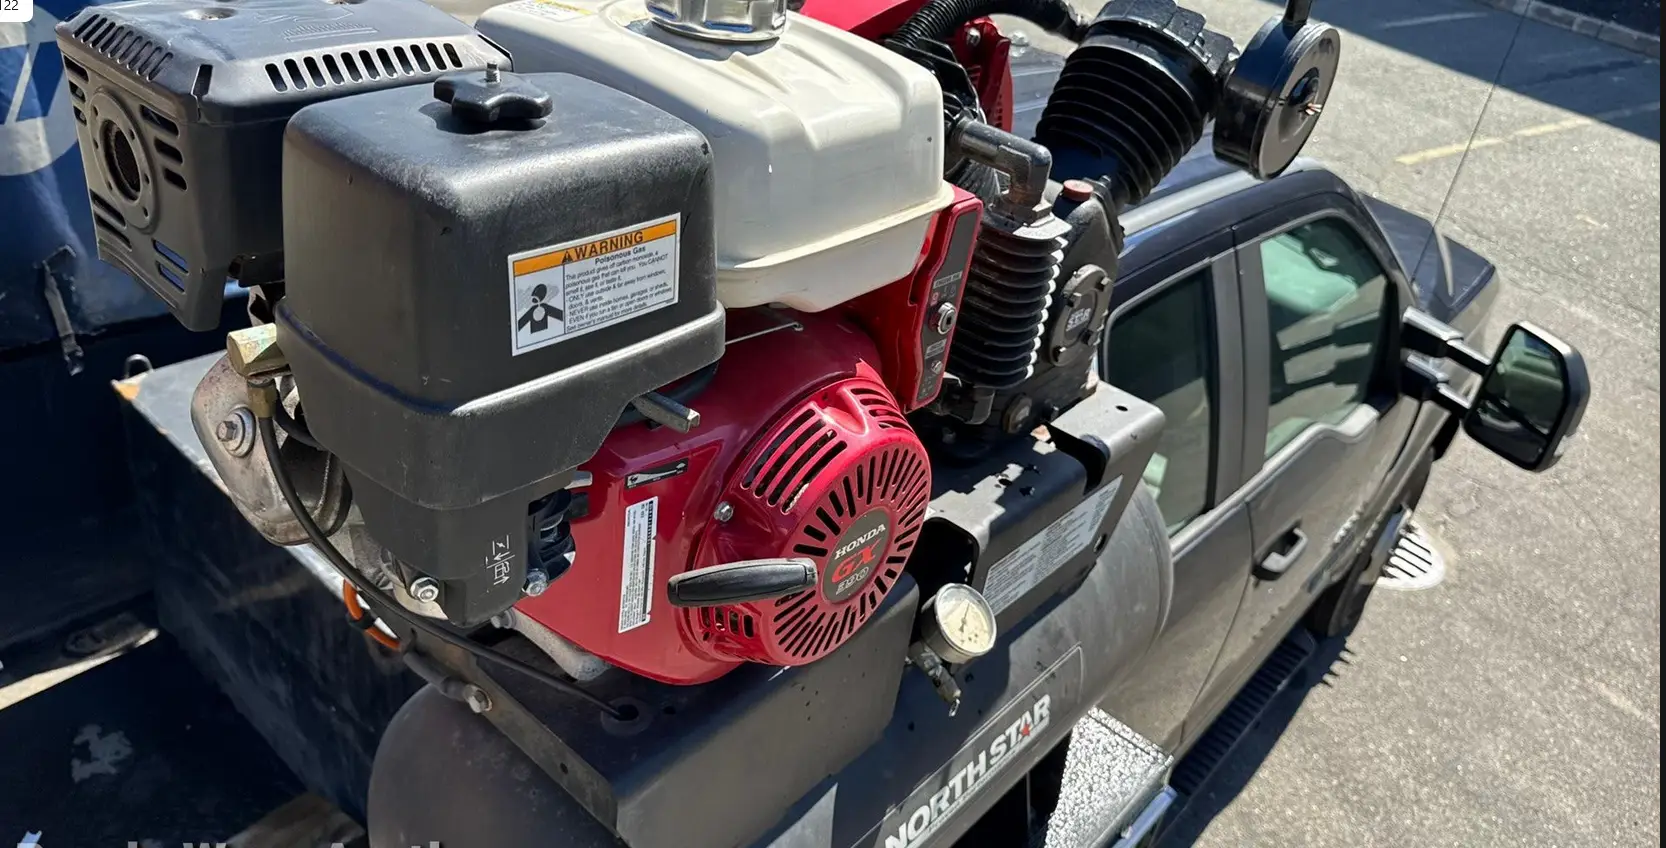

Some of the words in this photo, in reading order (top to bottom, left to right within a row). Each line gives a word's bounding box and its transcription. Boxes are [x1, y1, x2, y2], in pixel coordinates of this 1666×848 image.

[575, 231, 643, 260] WARNING
[596, 251, 632, 265] Poisonous
[834, 524, 886, 560] HONDA
[831, 539, 882, 583] GX
[885, 750, 987, 848] NORTH
[990, 694, 1051, 765] STAR
